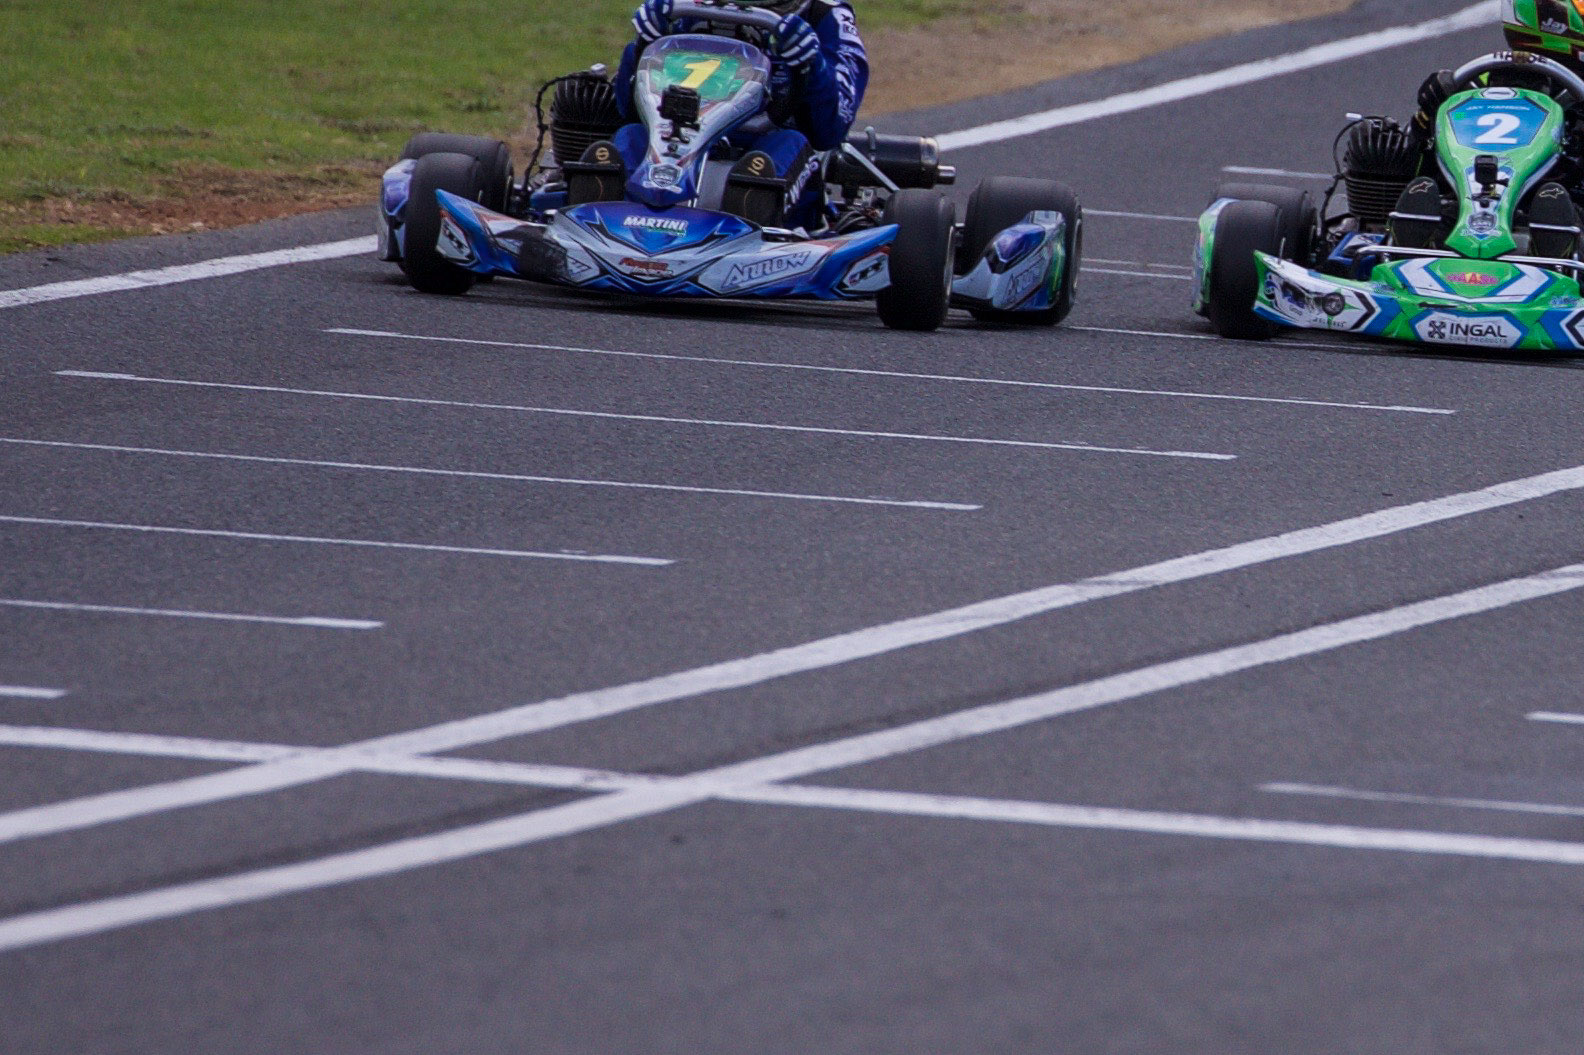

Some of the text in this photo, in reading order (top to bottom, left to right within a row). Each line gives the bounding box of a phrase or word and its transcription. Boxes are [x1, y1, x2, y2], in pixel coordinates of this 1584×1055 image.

[680, 59, 721, 89] 1
[1475, 112, 1520, 144] 2
[623, 215, 689, 231] MARTINI
[721, 251, 811, 290] ARROW
[1449, 322, 1508, 338] INGAL
